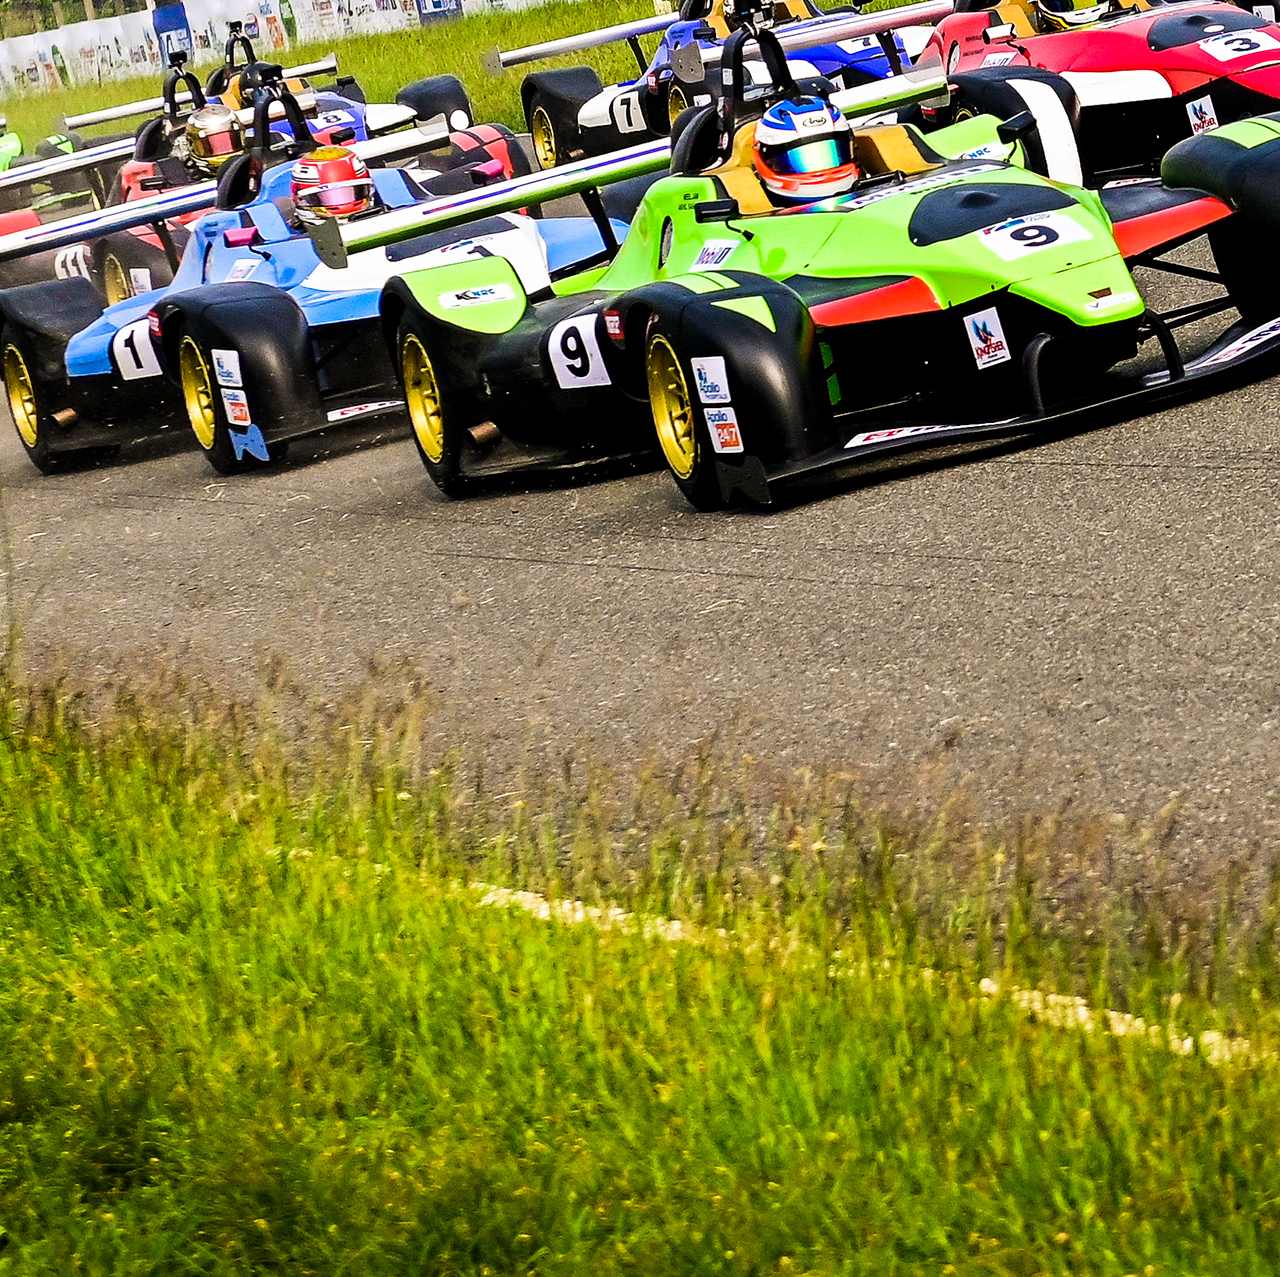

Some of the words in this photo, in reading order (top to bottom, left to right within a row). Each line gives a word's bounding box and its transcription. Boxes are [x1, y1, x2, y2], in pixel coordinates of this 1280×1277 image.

[1224, 38, 1260, 52] 3
[620, 97, 634, 127] 7
[1010, 225, 1059, 247] 9
[124, 330, 144, 369] 1
[561, 326, 590, 378] 9
